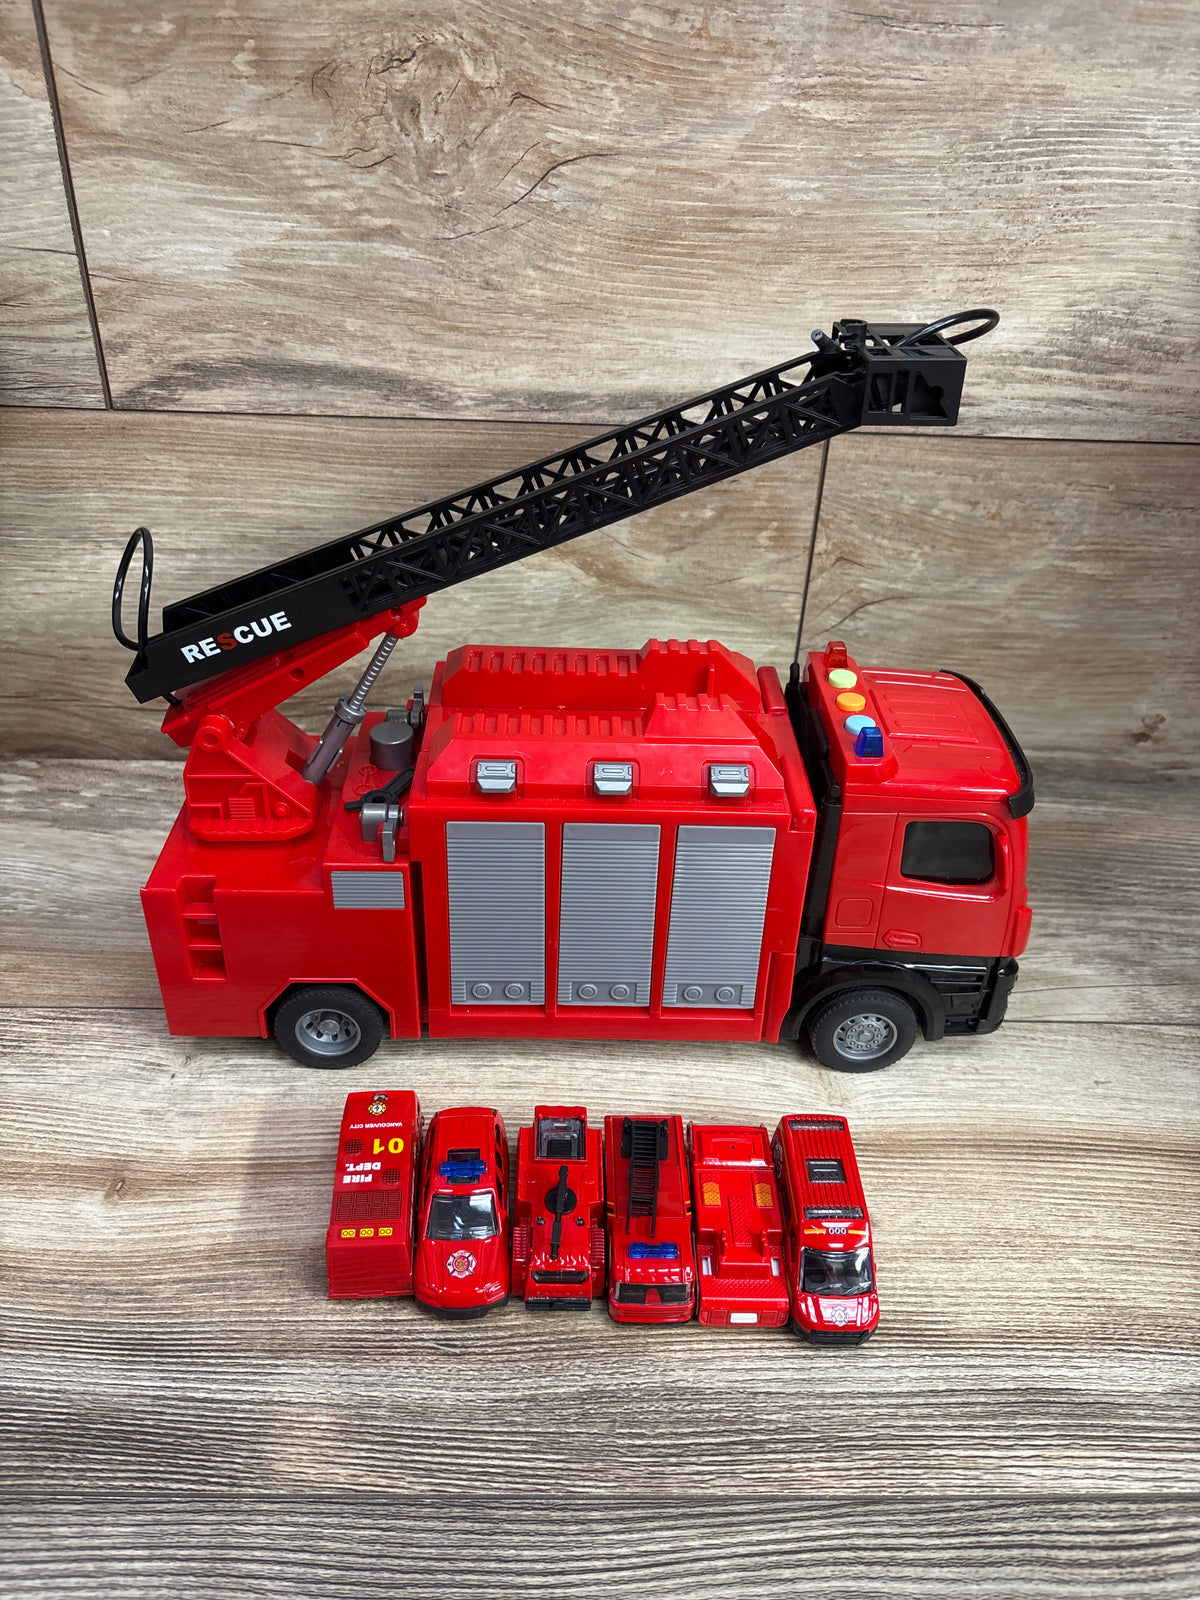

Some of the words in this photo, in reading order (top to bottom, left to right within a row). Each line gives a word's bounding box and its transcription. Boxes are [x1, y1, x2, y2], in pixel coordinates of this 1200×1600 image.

[180, 611, 292, 664] RESCUE
[373, 1138, 404, 1154] 01
[345, 1162, 381, 1172] DEPT.
[342, 1174, 373, 1184] FIRE
